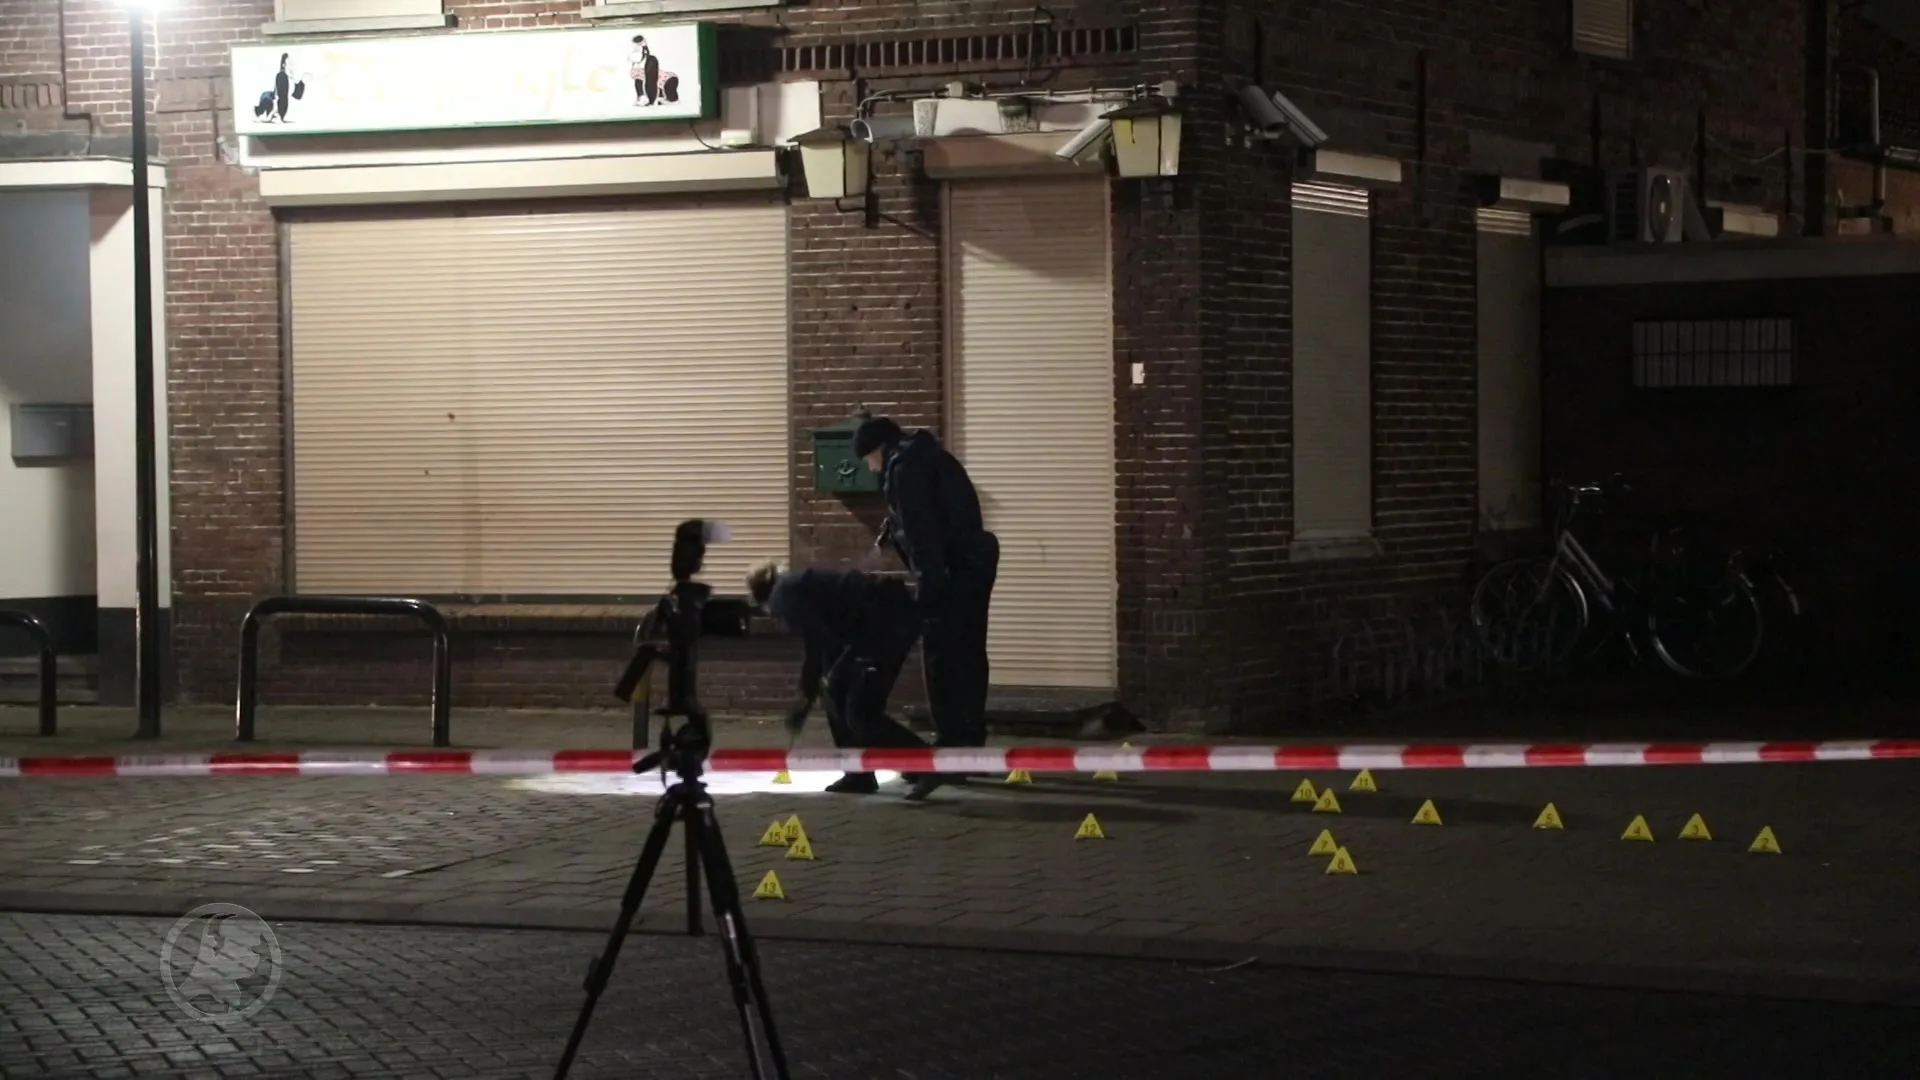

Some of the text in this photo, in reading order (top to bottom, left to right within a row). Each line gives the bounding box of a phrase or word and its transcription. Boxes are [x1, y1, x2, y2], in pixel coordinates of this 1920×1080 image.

[1359, 777, 1368, 787] 11
[1299, 788, 1312, 799] 10
[1084, 823, 1096, 834] 12
[769, 831, 781, 842] 15
[794, 845, 806, 855] 14
[763, 882, 776, 894] 13
